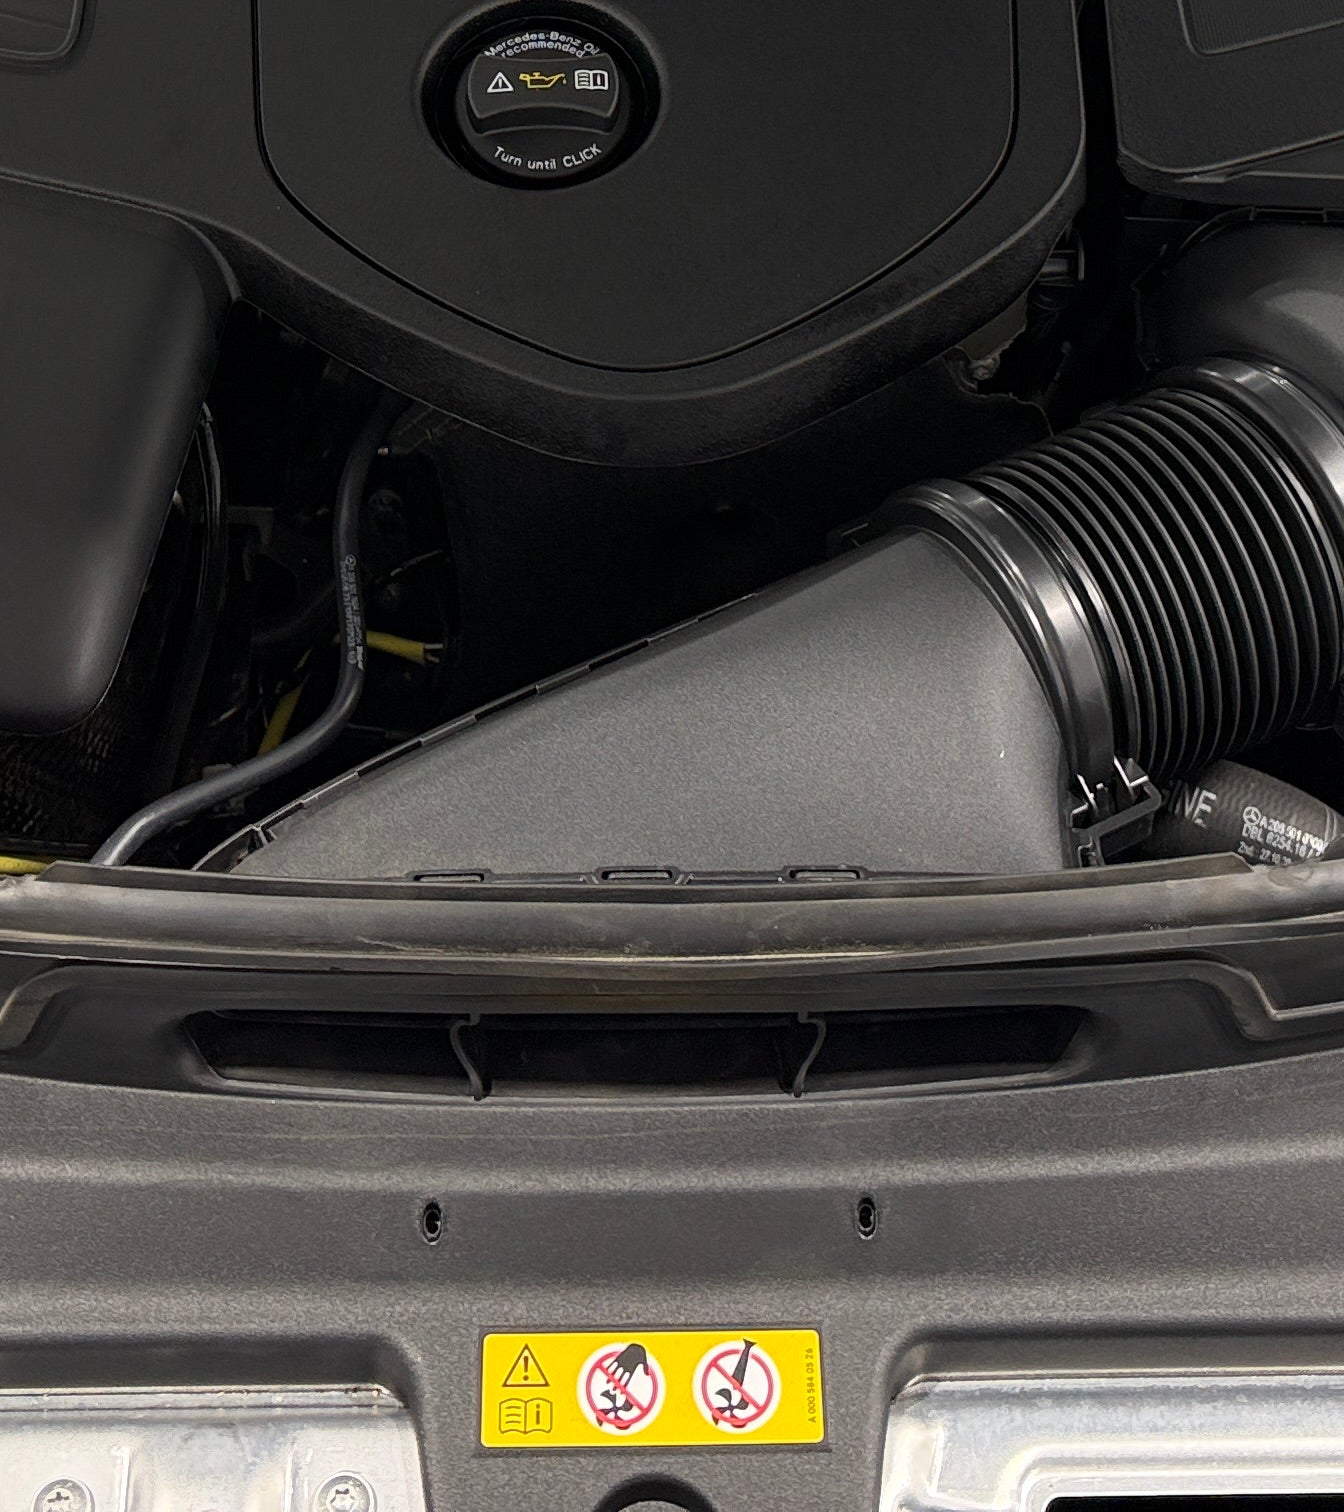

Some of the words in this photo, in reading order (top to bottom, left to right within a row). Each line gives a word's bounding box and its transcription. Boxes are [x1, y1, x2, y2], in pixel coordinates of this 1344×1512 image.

[484, 31, 582, 57] Mercedes-Benz
[583, 39, 602, 56] Oil
[500, 40, 586, 59] recommended
[493, 145, 522, 168] Turn
[527, 158, 556, 170] until
[562, 143, 602, 168] CLICK
[807, 1396, 816, 1414] 000
